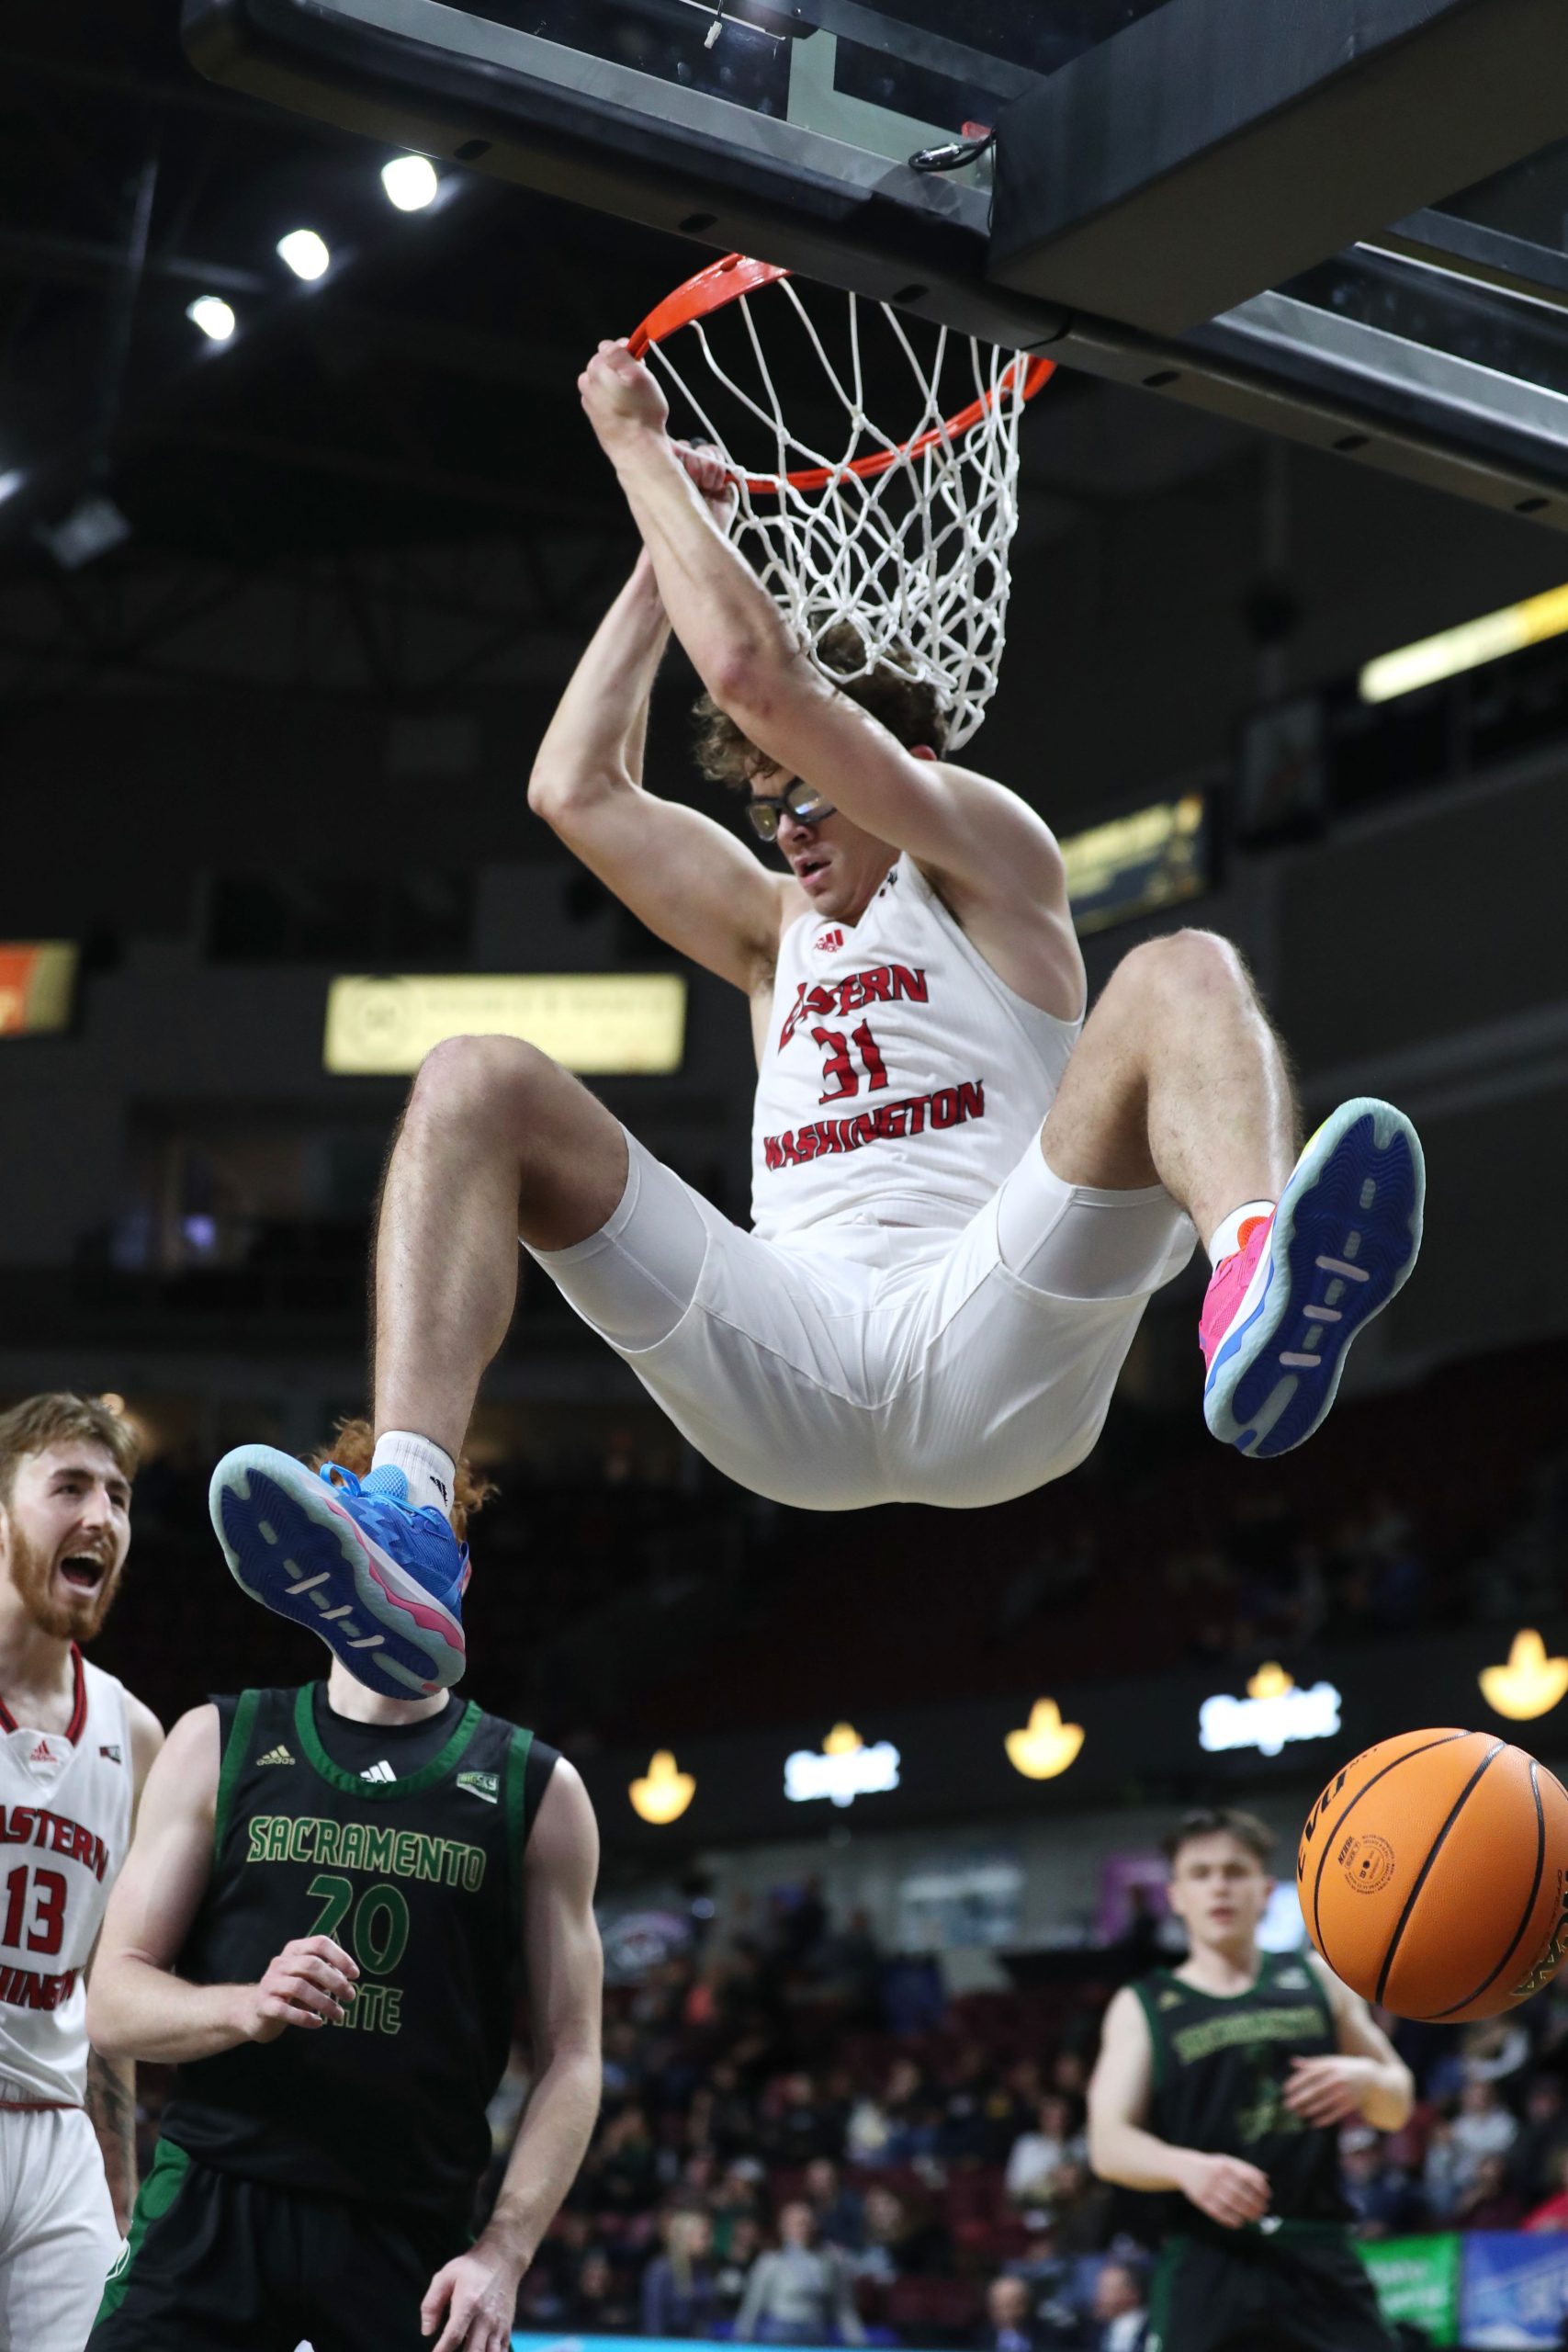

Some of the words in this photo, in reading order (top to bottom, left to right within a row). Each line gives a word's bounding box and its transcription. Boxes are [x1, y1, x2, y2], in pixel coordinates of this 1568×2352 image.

[810, 1018, 889, 1105] 31
[763, 1080, 985, 1171] WASHINGTON
[256, 1756, 296, 1766] adidas
[246, 1816, 487, 1892] SACRAMENTO
[1, 1864, 68, 1956] 13
